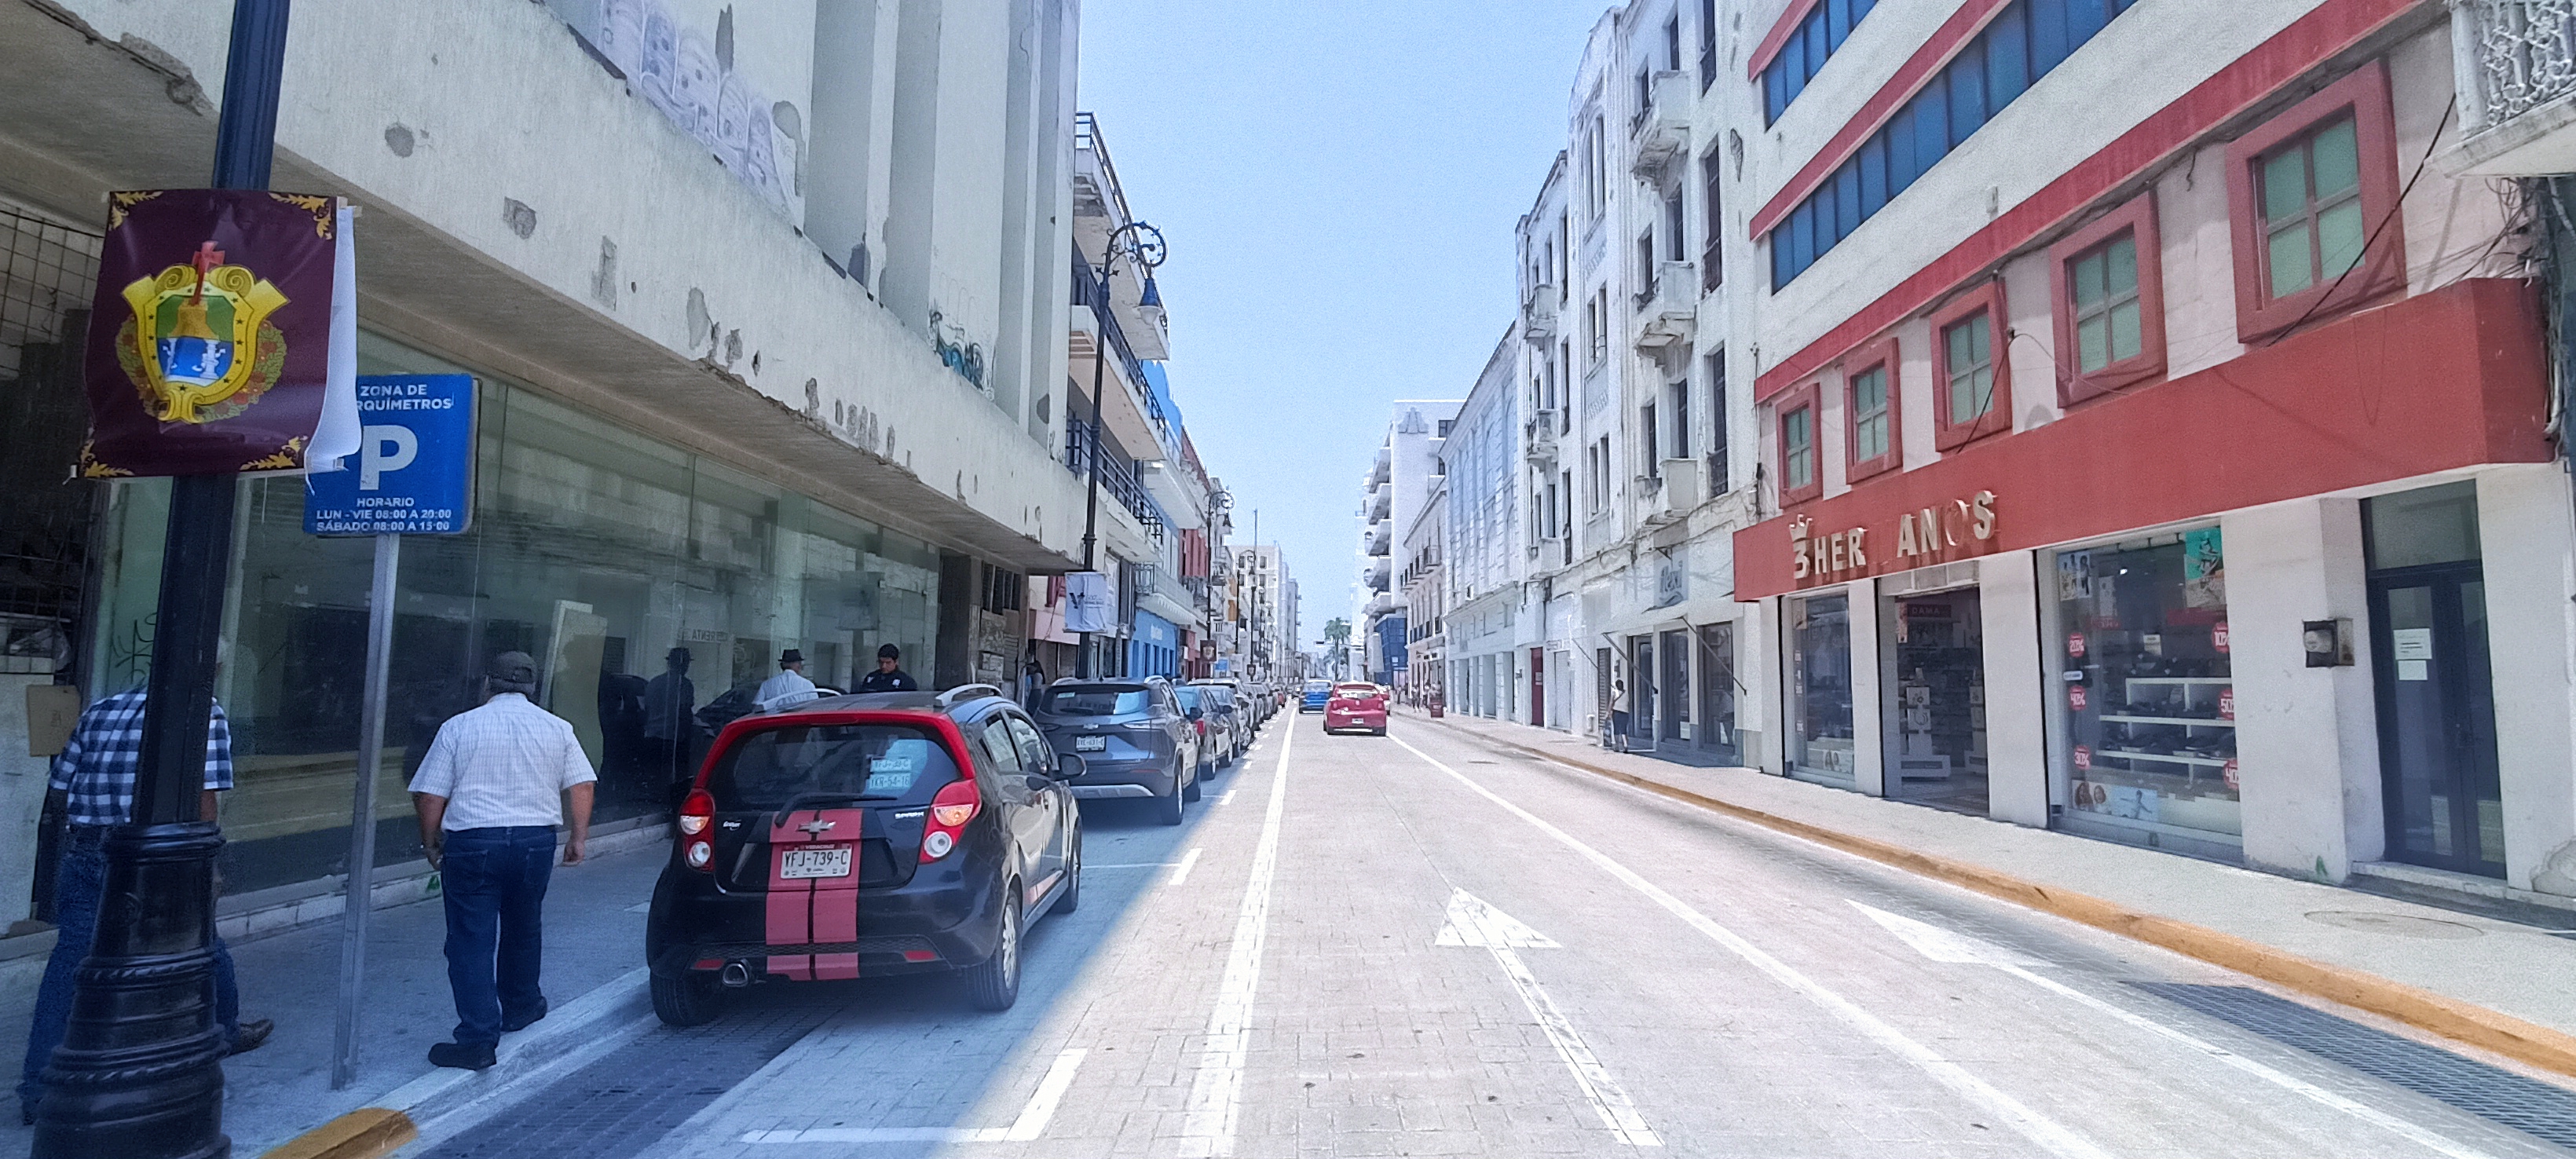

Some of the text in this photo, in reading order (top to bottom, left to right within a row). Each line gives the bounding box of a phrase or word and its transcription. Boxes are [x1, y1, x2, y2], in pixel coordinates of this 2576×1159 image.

[360, 384, 428, 397] ZONA DE
[357, 397, 452, 411] RQUÍMETROS
[360, 425, 418, 491] P
[357, 497, 415, 507] HORARIO
[316, 510, 342, 520] LUN
[353, 510, 372, 519] VIE
[375, 510, 407, 519] 08:00
[408, 510, 419, 519] A
[420, 509, 452, 519] 20:00
[316, 519, 450, 532] SÁBADO 08:00 A 15:00
[2225, 766, 2239, 784] 40
[785, 850, 849, 868] YFJ-739-C
